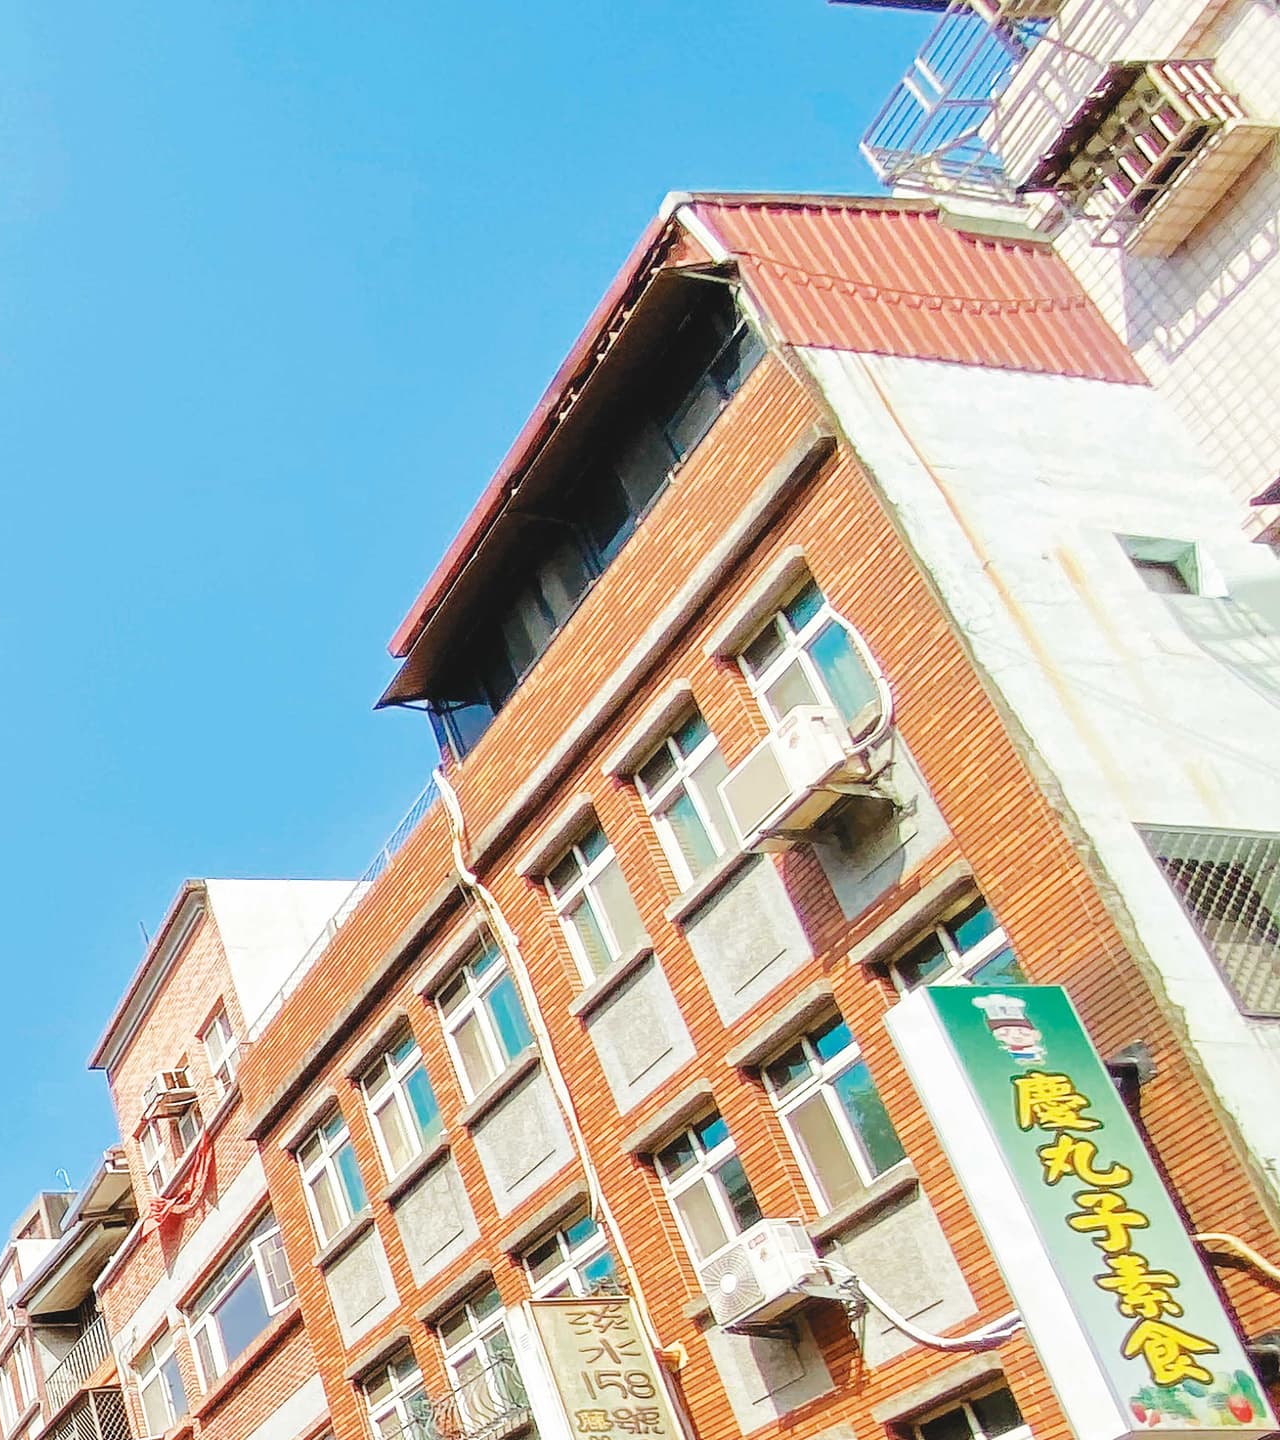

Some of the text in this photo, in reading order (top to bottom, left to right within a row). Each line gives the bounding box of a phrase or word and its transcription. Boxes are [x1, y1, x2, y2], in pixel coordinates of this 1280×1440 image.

[1010, 1071, 1220, 1385] 慶丸子素食
